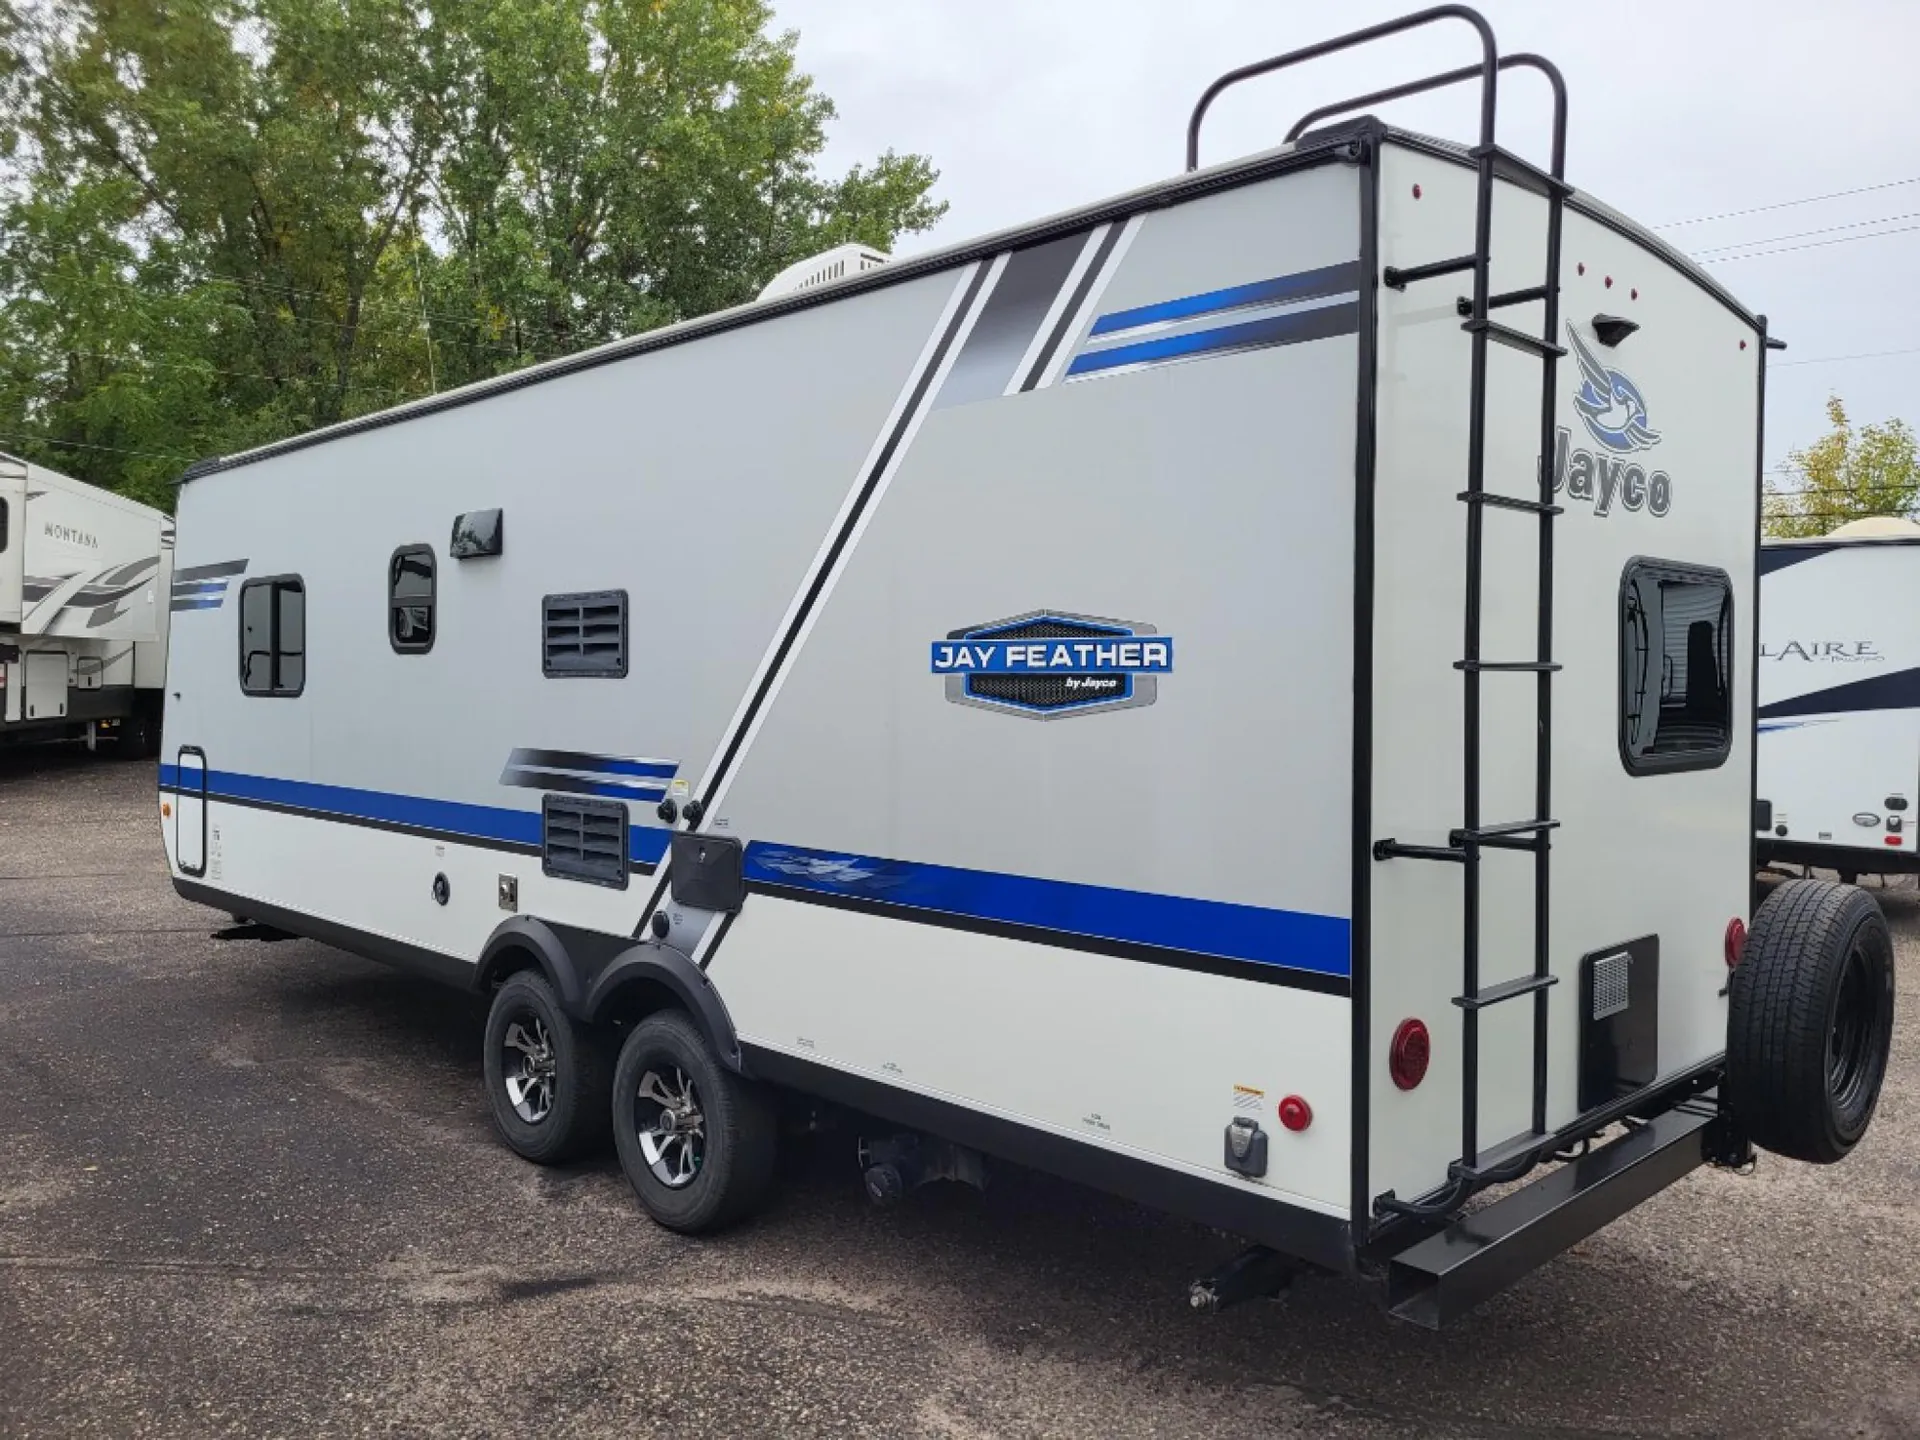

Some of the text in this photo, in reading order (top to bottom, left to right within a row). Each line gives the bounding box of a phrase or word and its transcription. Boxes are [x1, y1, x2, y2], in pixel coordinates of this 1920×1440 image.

[1537, 425, 1672, 517] Jayco
[44, 521, 99, 549] MONTANA
[935, 642, 1168, 669] JAY FEATHER
[1065, 676, 1117, 690] by Jayco
